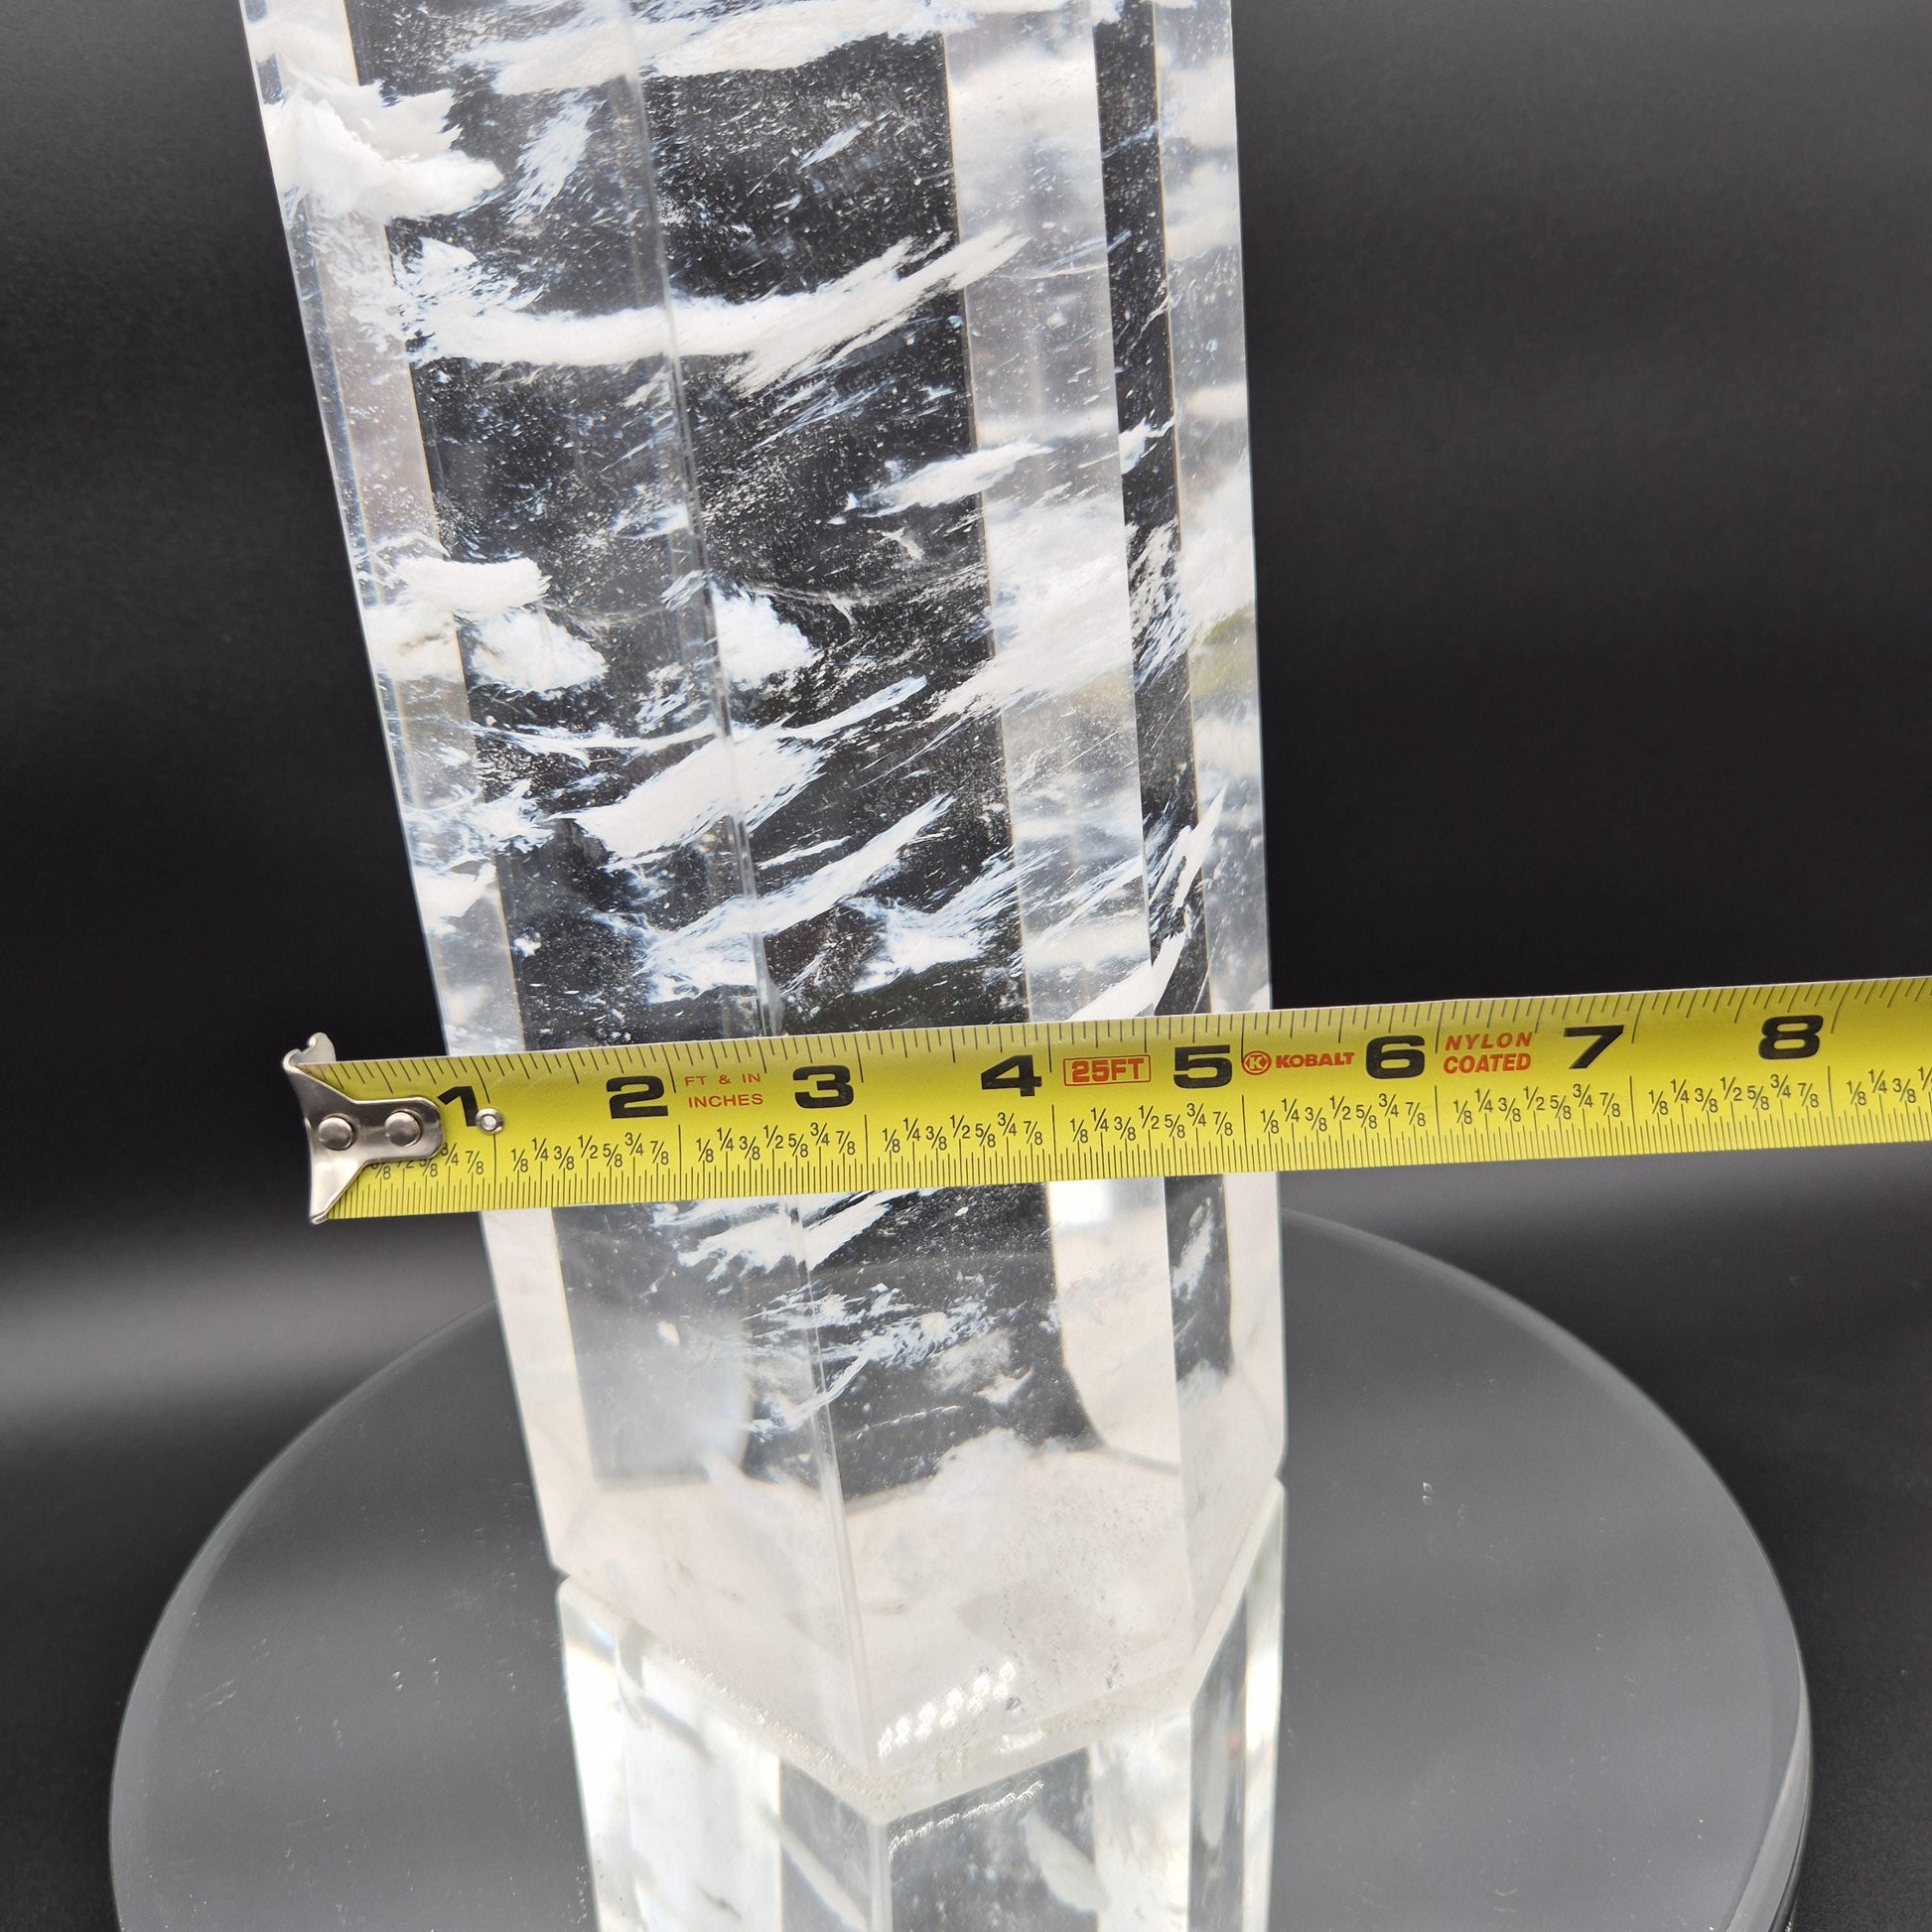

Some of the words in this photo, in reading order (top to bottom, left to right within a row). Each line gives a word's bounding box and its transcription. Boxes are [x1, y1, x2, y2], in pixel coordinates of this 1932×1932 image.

[1366, 1035, 1425, 1079] 6
[1445, 1032, 1533, 1050] NYLON
[1564, 1025, 1624, 1069] 7
[1758, 1015, 1824, 1059] 8
[685, 1076, 707, 1086] FT
[719, 1074, 731, 1084] &
[743, 1073, 760, 1083] IN
[981, 1054, 1041, 1096] 4
[1072, 1058, 1144, 1082] 25FT
[1173, 1044, 1232, 1089] 5
[1276, 1052, 1354, 1068] KOBALT
[1444, 1053, 1531, 1074] COATED
[437, 1085, 479, 1127] 1
[607, 1075, 668, 1119] 2
[688, 1093, 763, 1108] INCHES
[793, 1065, 854, 1109] 3
[466, 1151, 484, 1174] 7/8
[511, 1149, 528, 1173] 1/8
[532, 1138, 548, 1161] 1/4
[554, 1147, 574, 1170] 3/8
[578, 1135, 598, 1159] 1/2
[603, 1144, 622, 1168] 5/8
[624, 1133, 643, 1156] 3/4
[650, 1141, 669, 1165] 7/8
[696, 1139, 714, 1163] 1/8
[717, 1128, 734, 1151] 1/4
[740, 1136, 759, 1160] 3/8
[763, 1125, 783, 1149] 1/2
[788, 1134, 808, 1158] 5/8
[810, 1123, 830, 1146] 3/4
[836, 1131, 855, 1155] 7/8
[883, 1129, 900, 1153] 1/8
[903, 1118, 920, 1141] 1/4
[926, 1126, 946, 1150] 3/8
[950, 1115, 970, 1139] 1/2
[975, 1124, 996, 1148] 5/8
[998, 1112, 1017, 1136] 3/4
[1024, 1121, 1042, 1145] 7/8
[1070, 1119, 1088, 1143] 1/8
[1091, 1108, 1108, 1131] 1/4
[1114, 1117, 1136, 1141] 3/8
[1139, 1105, 1159, 1129] 1/2
[1165, 1114, 1185, 1138] 5/8
[1187, 1103, 1206, 1127] 3/4
[1213, 1112, 1232, 1136] 7/8
[1261, 1109, 1279, 1134] 1/8
[1282, 1098, 1300, 1122] 1/4
[1305, 1107, 1327, 1132] 3/8
[1329, 1096, 1350, 1120] 1/2
[1356, 1105, 1376, 1129] 5/8
[1379, 1093, 1398, 1117] 3/4
[1406, 1102, 1426, 1127] 7/8
[1453, 1100, 1472, 1124] 1/8
[1474, 1088, 1493, 1112] 1/4
[1498, 1098, 1521, 1122] 3/8
[1524, 1086, 1544, 1110] 1/2
[1550, 1095, 1572, 1119] 5/8
[1573, 1084, 1592, 1107] 3/4
[1600, 1092, 1620, 1117] 7/8
[1649, 1090, 1668, 1115] 1/8
[1671, 1079, 1689, 1103] 1/4
[1695, 1088, 1718, 1113] 3/8
[1721, 1076, 1741, 1101] 1/2
[1747, 1085, 1769, 1110] 5/8
[1770, 1074, 1791, 1098] 3/4
[1798, 1083, 1819, 1108] 7/8
[1847, 1081, 1866, 1105] 1/8
[1868, 1069, 1887, 1093] 1/4
[1892, 1078, 1916, 1103] 3/8
[1918, 1066, 1932, 1090] 1/
